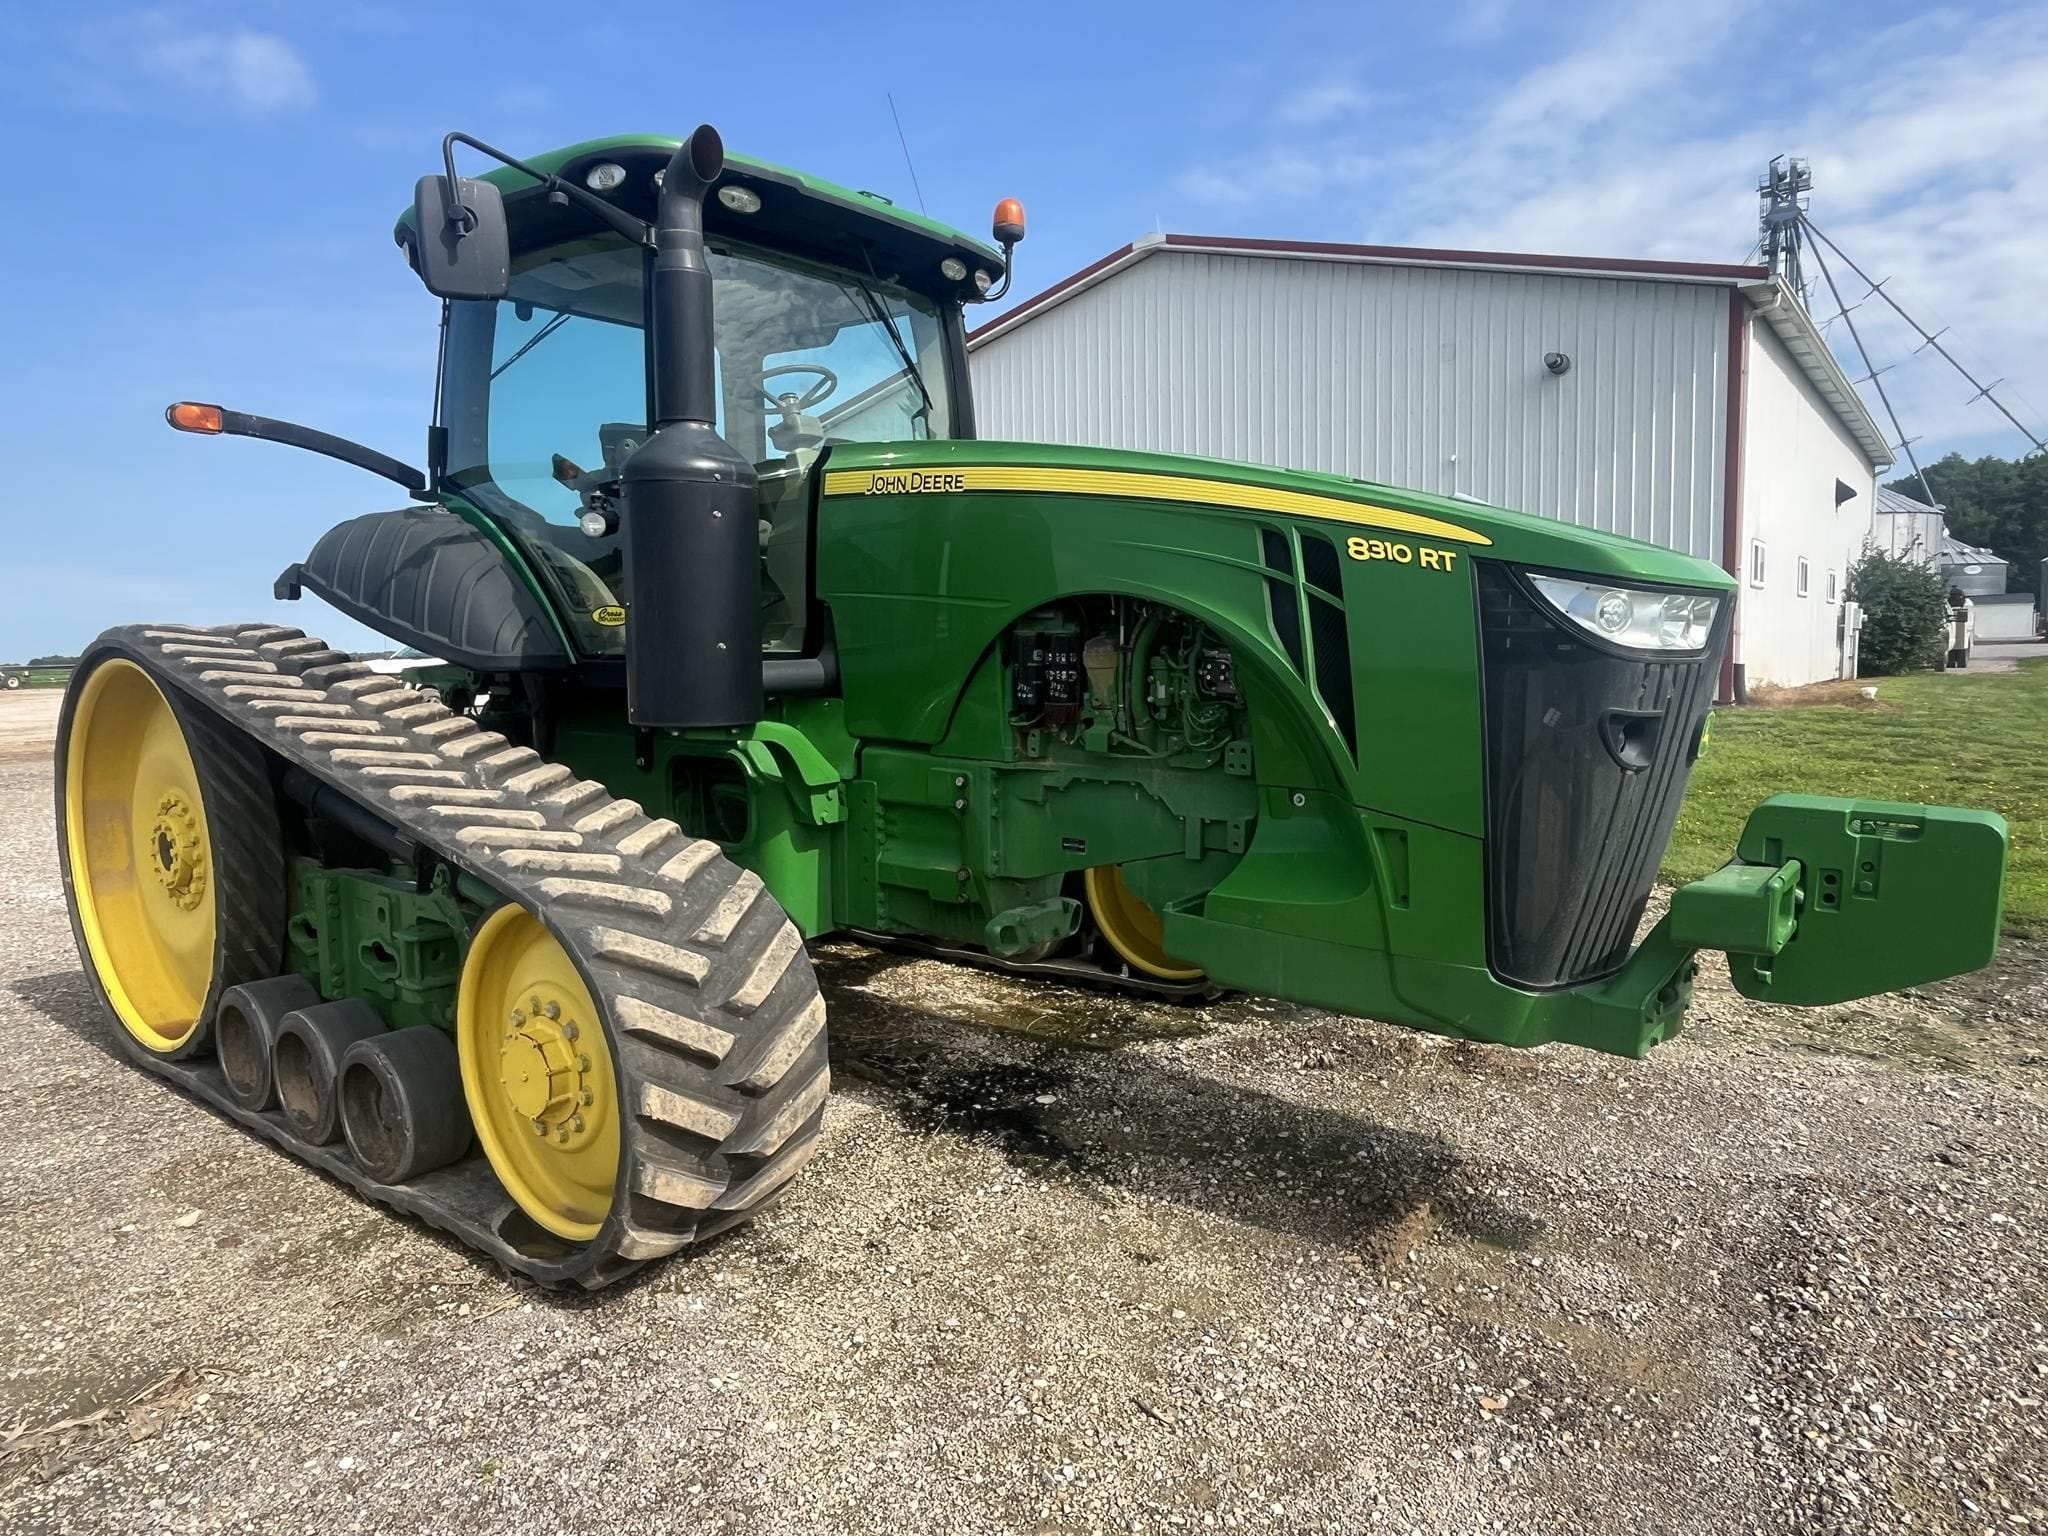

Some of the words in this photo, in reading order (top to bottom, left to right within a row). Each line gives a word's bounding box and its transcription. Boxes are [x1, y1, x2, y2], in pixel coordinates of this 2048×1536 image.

[866, 474, 907, 493] JOHN
[911, 472, 965, 492] DEERE
[1347, 537, 1412, 563] 8310
[1419, 547, 1457, 571] RT
